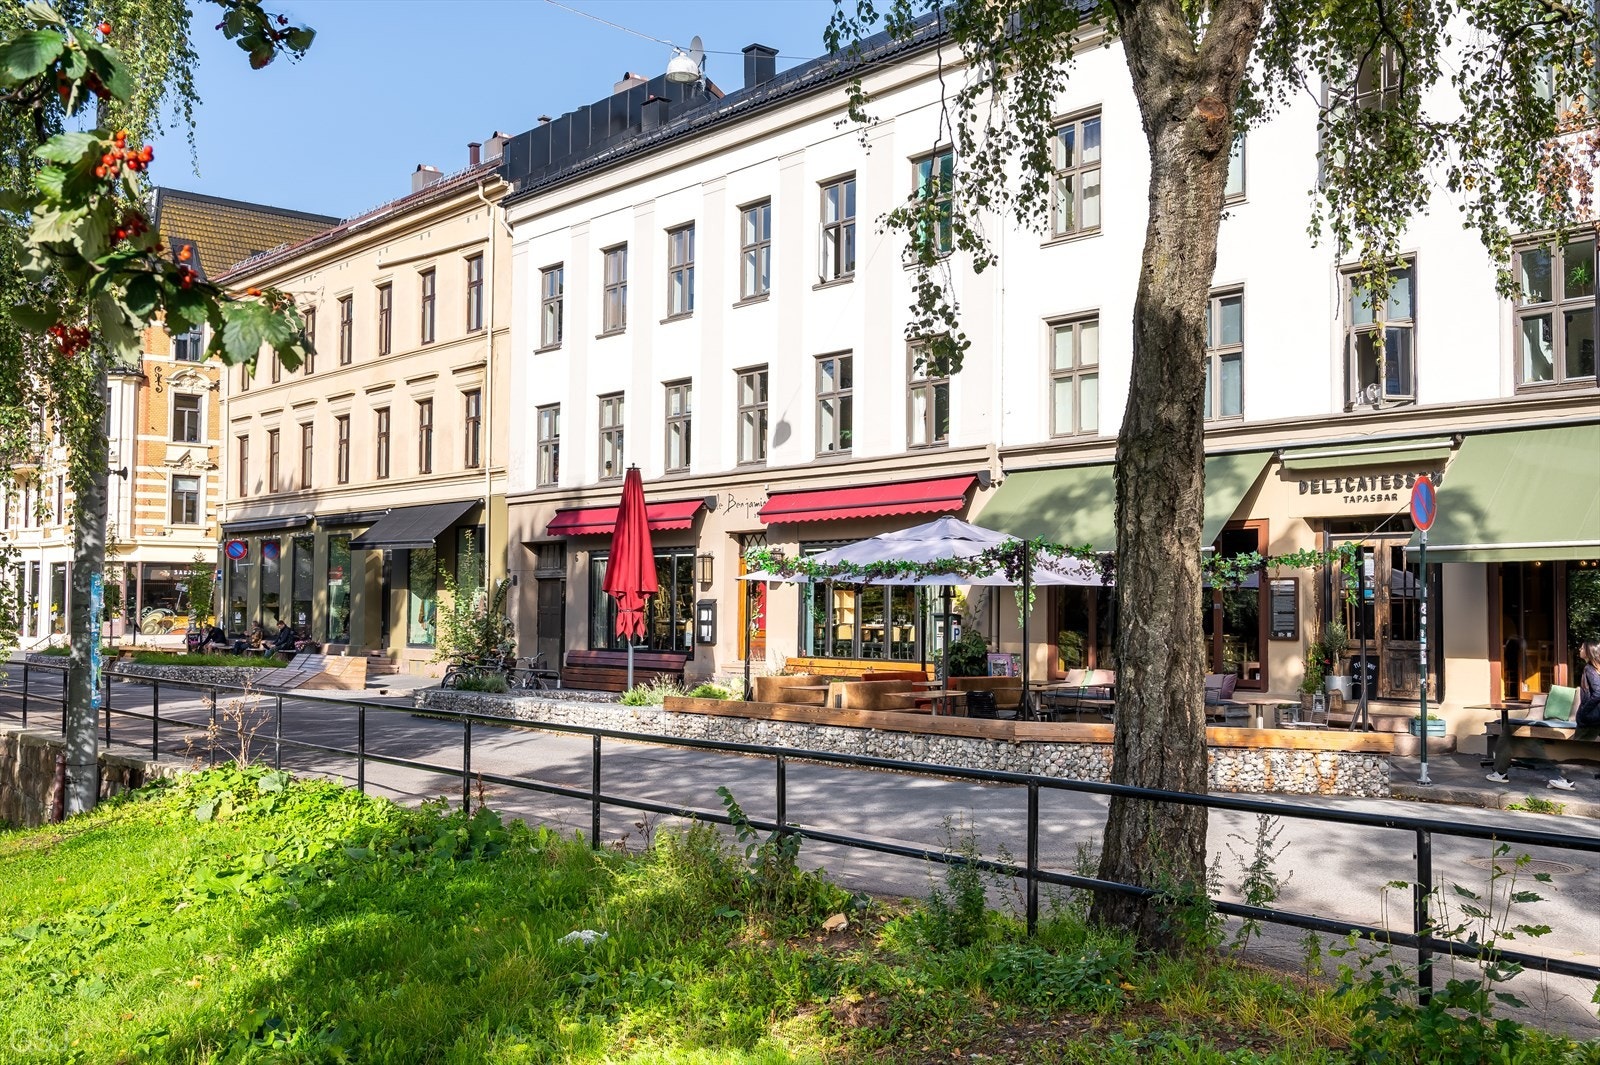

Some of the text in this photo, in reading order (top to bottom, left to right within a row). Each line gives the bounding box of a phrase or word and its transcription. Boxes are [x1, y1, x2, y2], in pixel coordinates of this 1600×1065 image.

[1298, 471, 1443, 495] DELICATESSN
[1343, 493, 1398, 504] TAPASBAR
[954, 628, 960, 641] P
